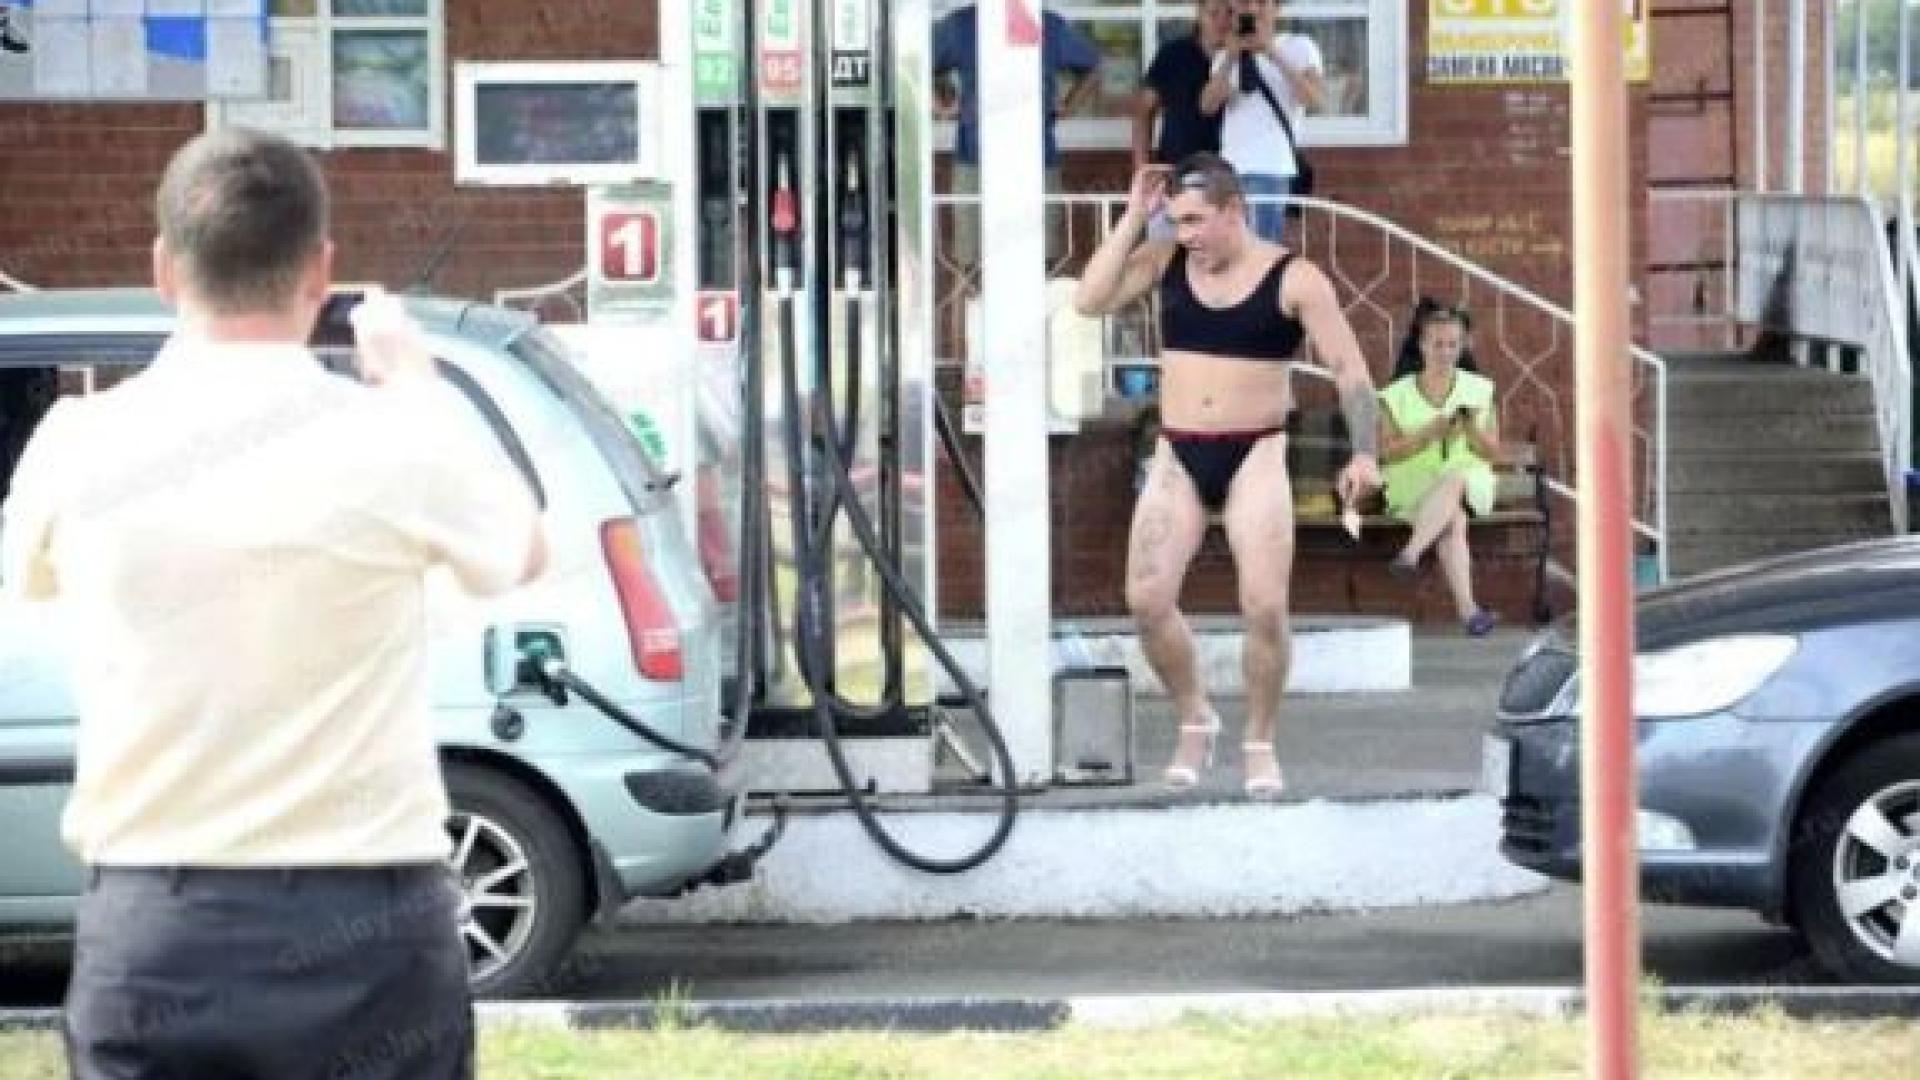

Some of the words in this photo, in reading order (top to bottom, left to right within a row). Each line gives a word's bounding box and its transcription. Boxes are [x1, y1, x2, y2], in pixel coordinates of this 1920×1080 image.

[833, 56, 867, 79] ДТ
[607, 219, 643, 275] 1
[703, 299, 727, 337] 1
